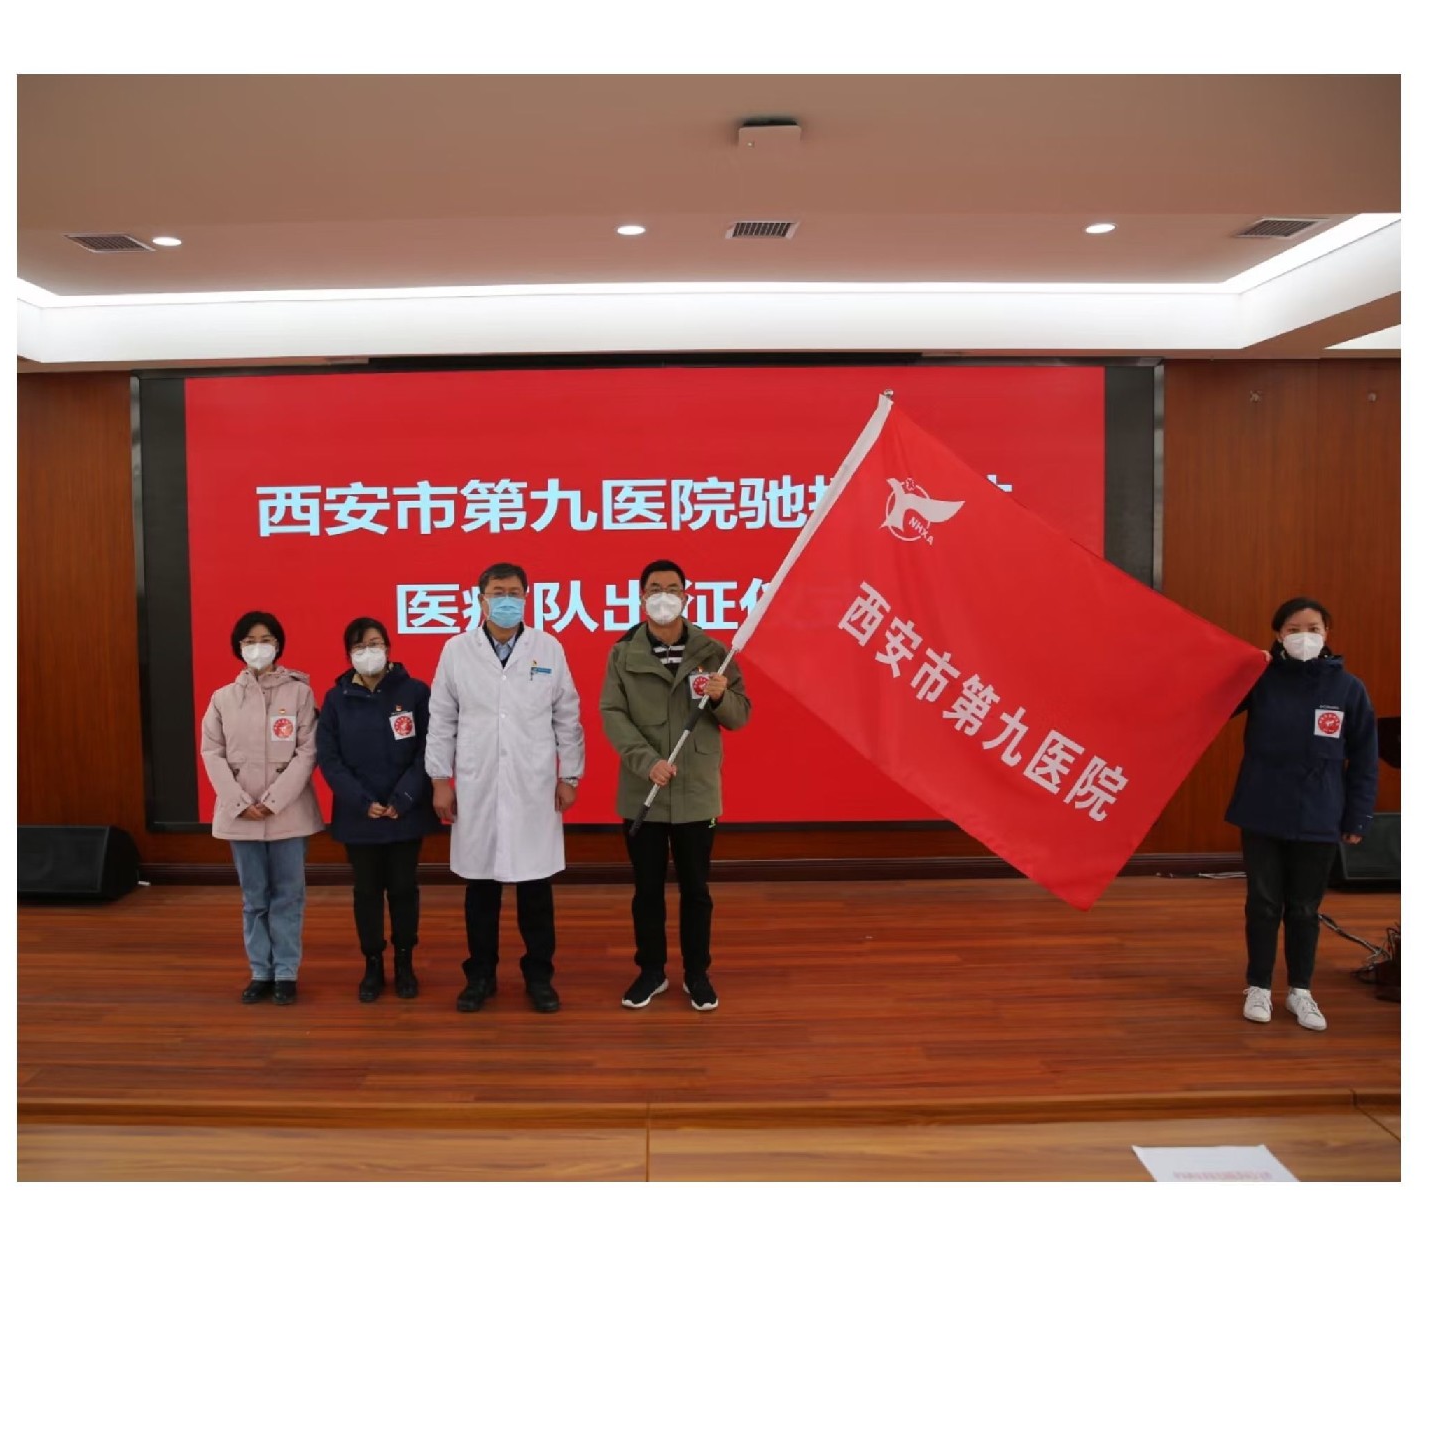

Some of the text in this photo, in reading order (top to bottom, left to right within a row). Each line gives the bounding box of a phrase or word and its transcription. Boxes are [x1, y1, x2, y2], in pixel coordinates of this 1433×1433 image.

[908, 516, 934, 546] NHXA
[838, 581, 1129, 822] 西安市第九医院
